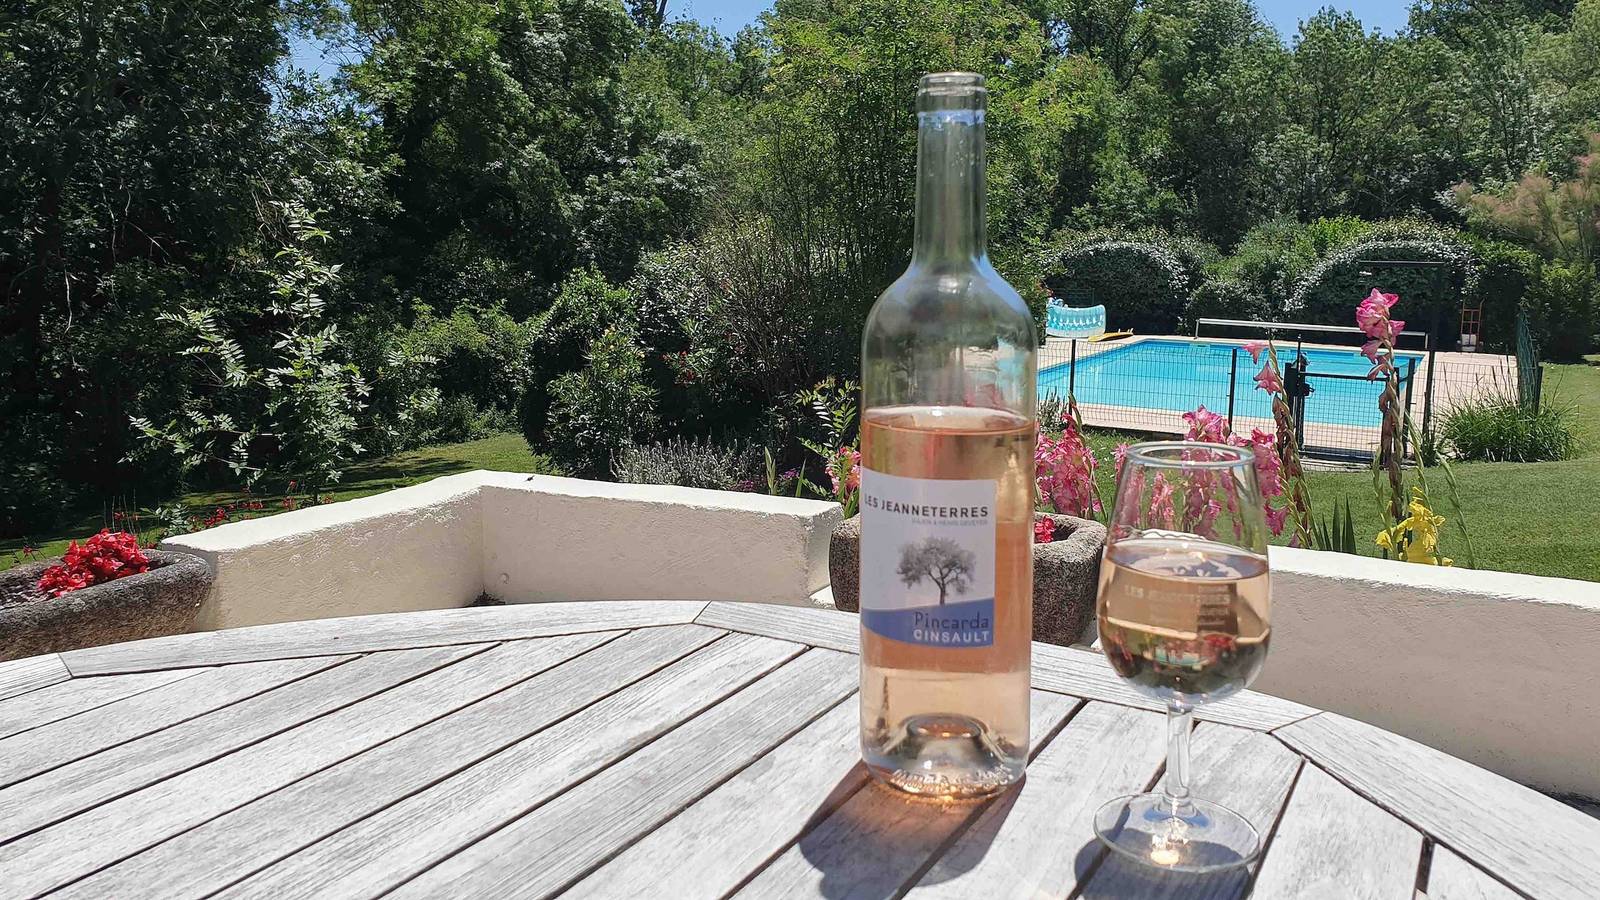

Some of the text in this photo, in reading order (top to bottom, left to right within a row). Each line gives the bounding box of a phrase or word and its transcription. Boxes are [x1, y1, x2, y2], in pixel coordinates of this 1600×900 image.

[864, 493, 989, 518] LES JEANNETERRES
[914, 611, 990, 629] Pincarda
[913, 629, 990, 643] CINSAULT
